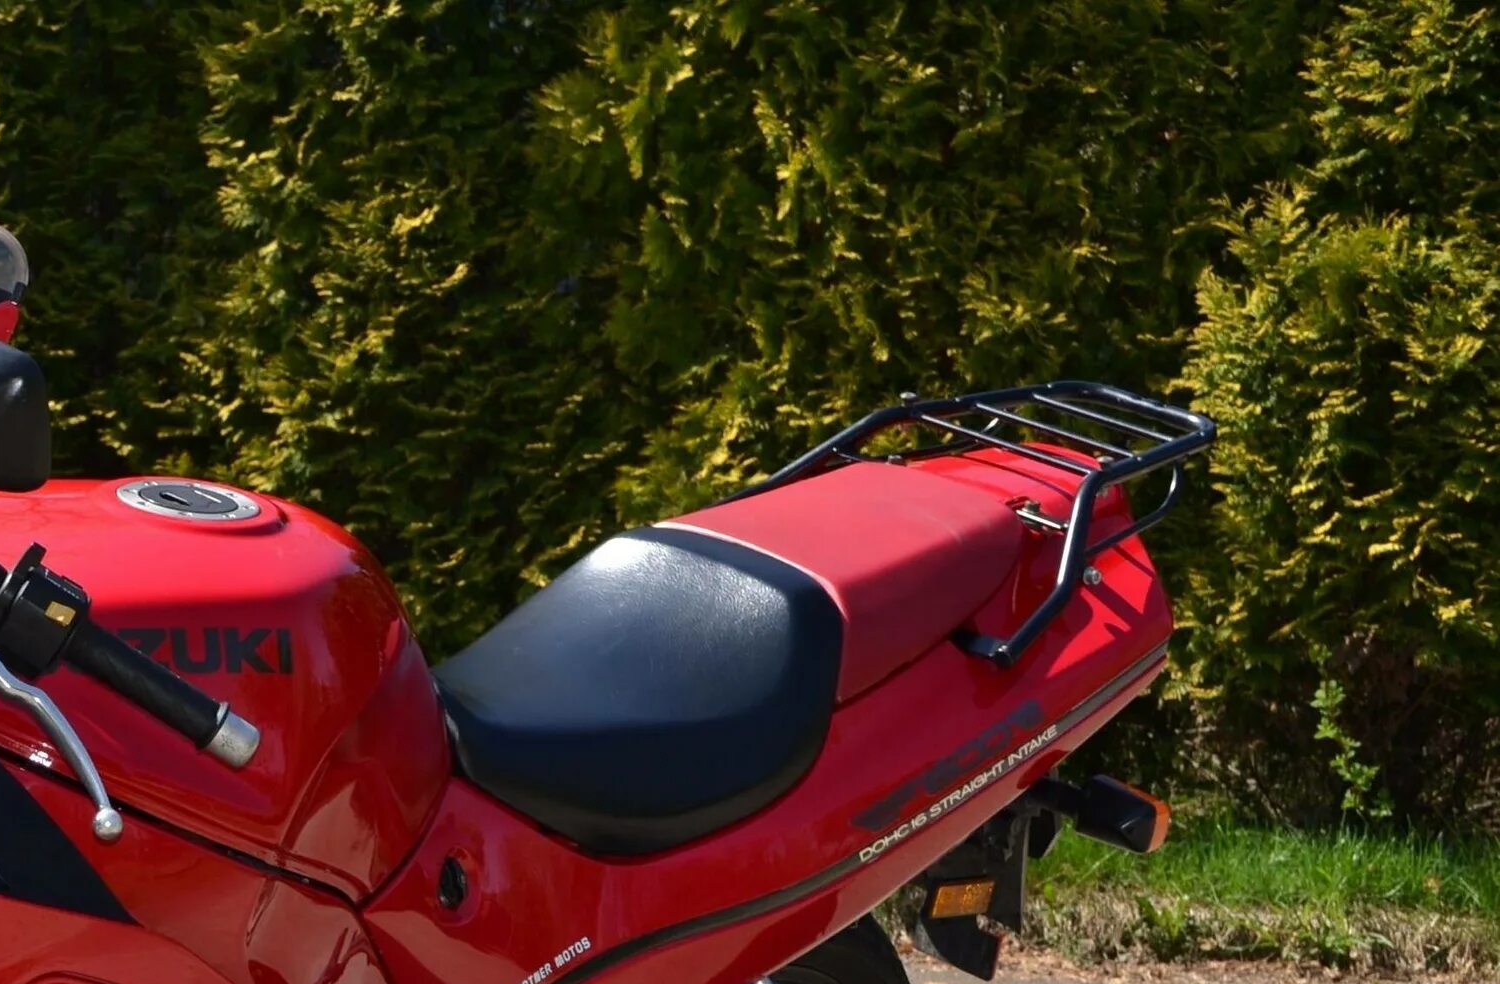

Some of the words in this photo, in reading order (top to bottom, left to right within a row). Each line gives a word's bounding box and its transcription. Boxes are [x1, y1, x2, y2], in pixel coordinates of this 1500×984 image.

[117, 627, 293, 674] ZUKI
[858, 823, 910, 862] DOHC
[911, 813, 928, 830] 16
[929, 759, 1005, 816] STRAIGHT
[1008, 724, 1058, 766] INTAKE
[554, 936, 592, 968] MOTOS
